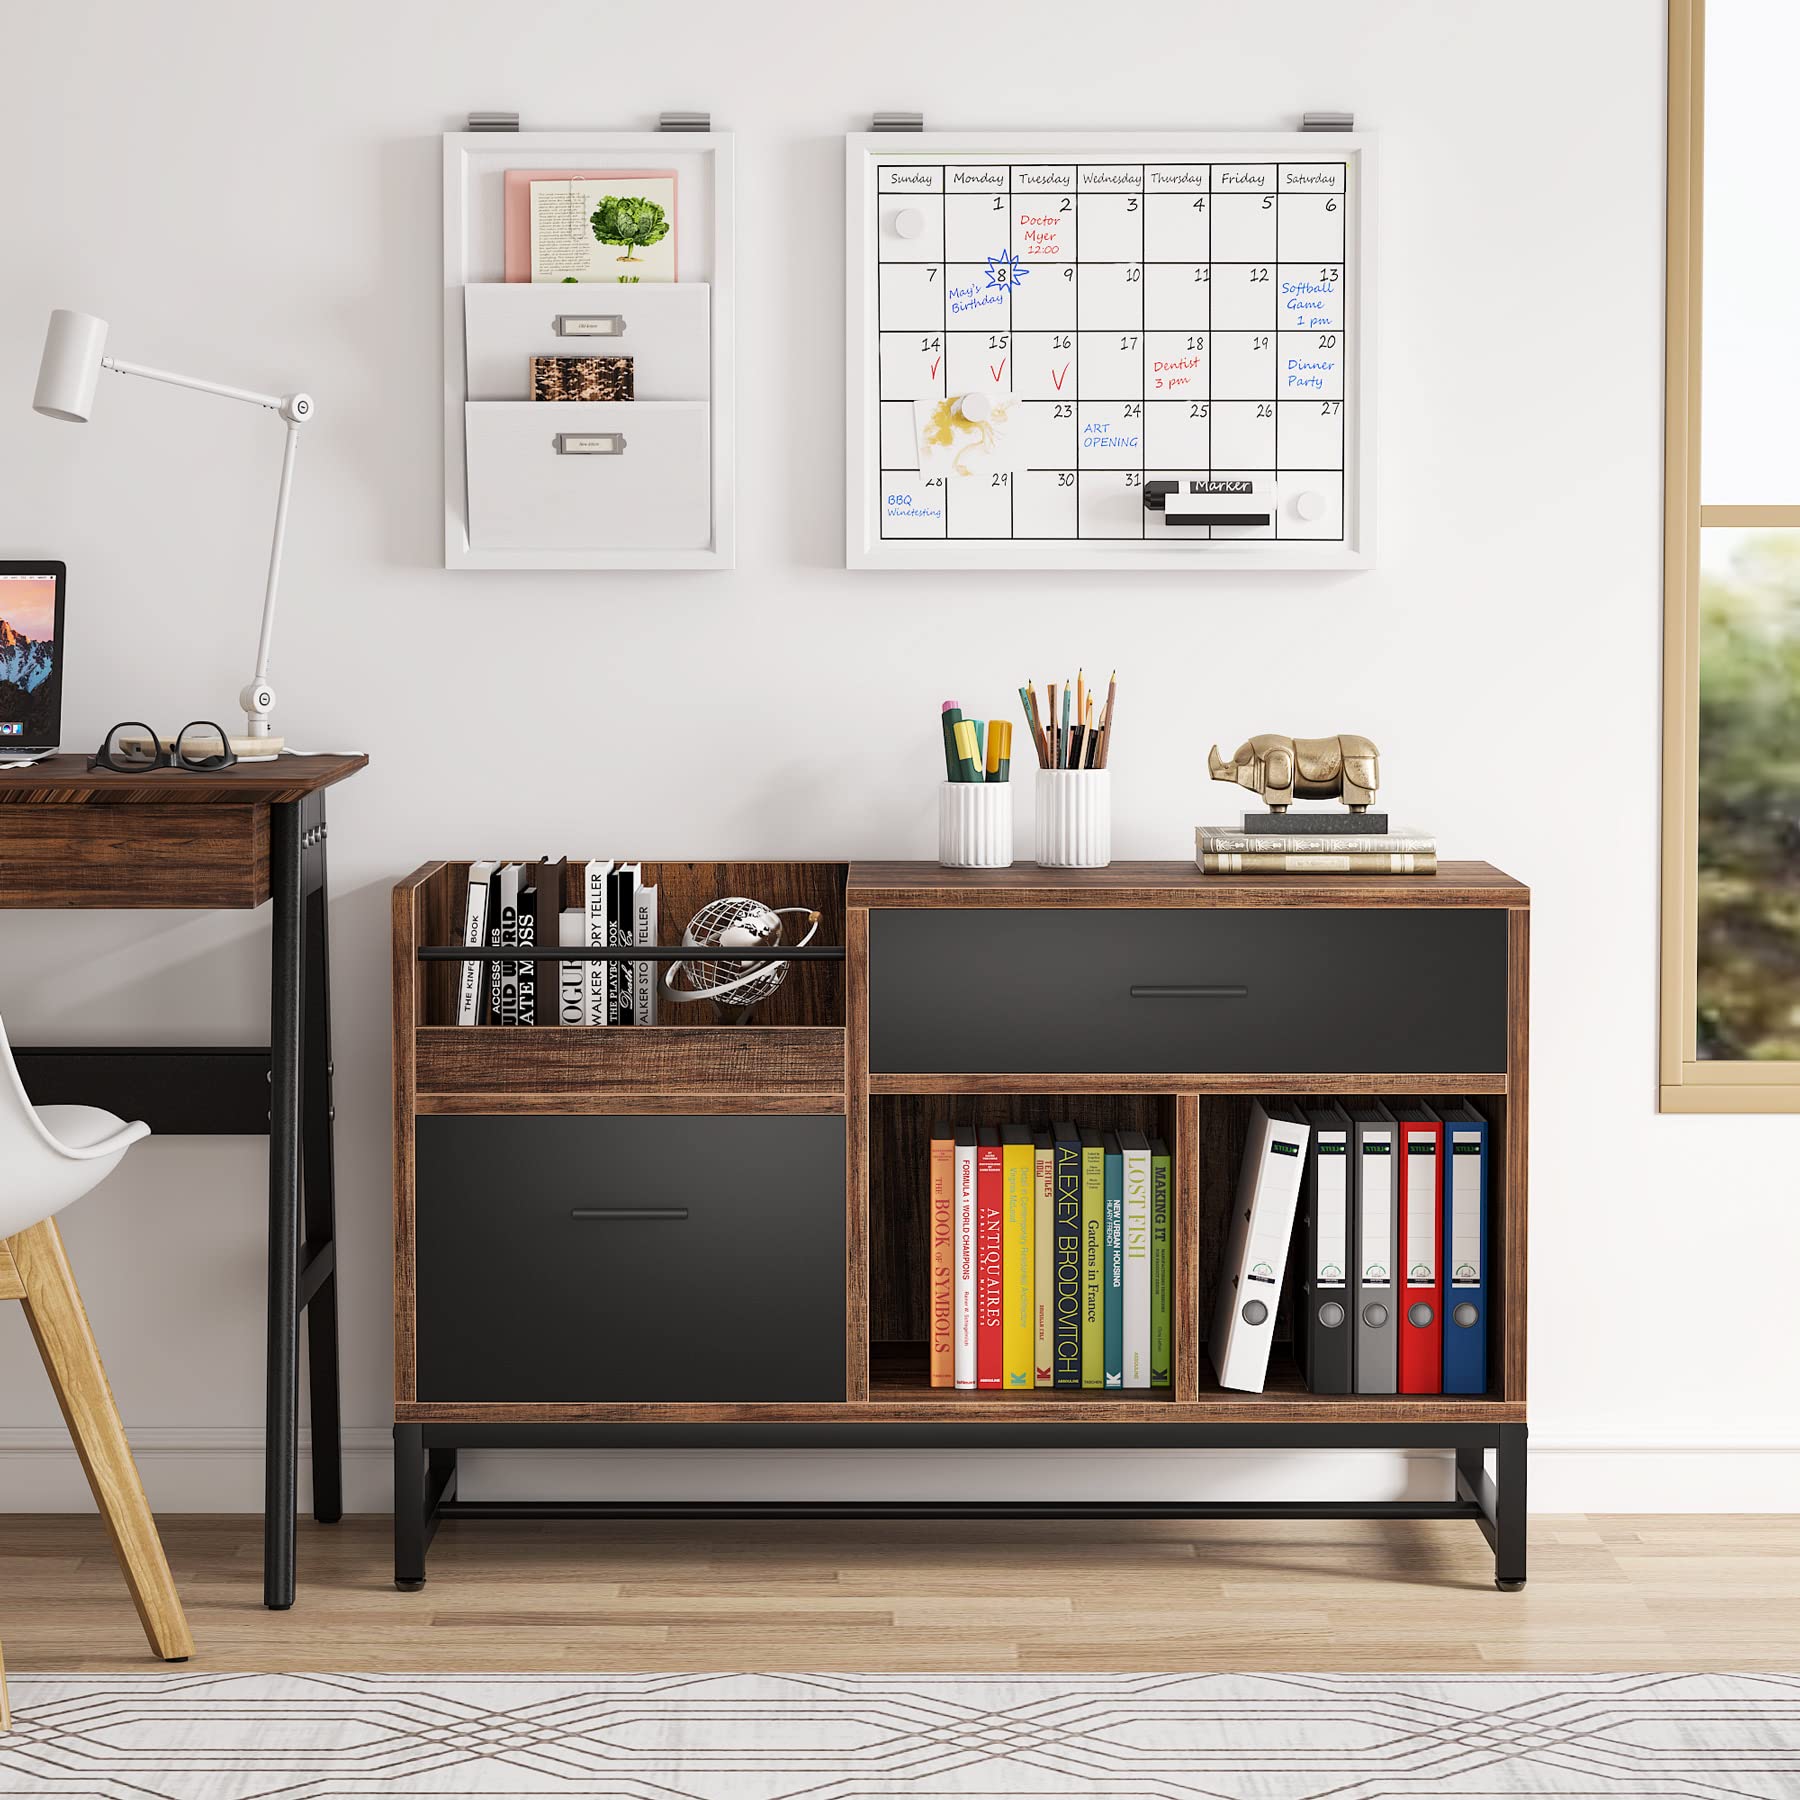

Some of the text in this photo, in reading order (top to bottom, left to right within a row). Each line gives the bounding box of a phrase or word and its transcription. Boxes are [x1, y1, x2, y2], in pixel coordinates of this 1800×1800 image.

[890, 173, 933, 187] Sunday
[953, 172, 1004, 186] Monday
[1019, 173, 1071, 186] Tuesday
[1083, 173, 1143, 187] Wednesday
[1151, 172, 1202, 186] Thursday
[1221, 173, 1265, 186] Friday
[1286, 173, 1336, 186] Saturday
[993, 197, 1004, 211] 1
[1059, 198, 1072, 213] 2
[1126, 198, 1138, 212] 3
[1193, 197, 1206, 212] 4
[1261, 196, 1275, 210] 5
[1325, 198, 1337, 212] 6
[1020, 214, 1061, 226] Doctor
[1024, 230, 1056, 244] Myer
[1027, 245, 1060, 255] 12:00
[926, 268, 937, 282] 7
[997, 268, 1006, 282] 8
[1063, 268, 1073, 282] 9
[1126, 268, 1140, 282] 10
[1194, 268, 1210, 282] 11
[1250, 268, 1269, 282] 12
[1319, 268, 1339, 282] 13
[949, 284, 981, 300] May's
[1281, 282, 1334, 296] Softball
[951, 294, 1003, 314] Birthday
[1286, 298, 1325, 310] Game
[1296, 315, 1333, 328] 1 pm
[921, 337, 941, 352] 14
[988, 335, 1010, 349] 15
[1052, 335, 1071, 349] 16
[1120, 337, 1138, 350] 17
[1186, 337, 1204, 350] 18
[1253, 337, 1269, 350] 19
[1318, 335, 1336, 349] 20
[1153, 356, 1200, 372] Dentist
[1287, 359, 1335, 371] Dinner
[1155, 377, 1191, 390] 3 pm
[1288, 375, 1323, 389] Party
[1053, 404, 1072, 419] 23
[1123, 404, 1141, 418] 24
[1189, 404, 1208, 418] 25
[1256, 404, 1273, 418] 26
[1321, 402, 1340, 416] 27
[1083, 423, 1110, 433] ART
[1083, 437, 1139, 448] OPENING
[991, 473, 1008, 488] 29
[1058, 473, 1075, 487] 30
[1125, 473, 1141, 487] 31
[1194, 480, 1251, 492] Marker
[887, 494, 913, 506] BBQ
[887, 508, 942, 518] Winetesting
[639, 906, 649, 944] TELLER
[502, 906, 517, 977] WRLD
[591, 874, 602, 1026] WALKER SORY TELLER
[464, 993, 473, 1012] THE
[470, 915, 479, 944] BOOK
[492, 928, 501, 1014] ACCESSIES
[610, 920, 618, 1022] THE PLAYBO BOOK
[562, 960, 584, 1026] OGUE
[618, 963, 634, 1010] Death
[519, 981, 534, 1026] ATE
[639, 988, 649, 1026] ALKER
[962, 1159, 970, 1197] FORMULA
[1044, 1160, 1053, 1198] TEXTILES
[1128, 1157, 1146, 1259] LOST FISH
[1155, 1166, 1166, 1242] MAKING IT
[962, 1204, 970, 1233] WORLD
[1113, 1199, 1121, 1288] NEW URBAN HOUSING
[962, 1233, 970, 1280] CHAMPIONS
[1057, 1147, 1079, 1374] ALEXEY BRODOVITCH
[935, 1177, 951, 1354] THE BOOK OF SYMBOLS
[986, 1208, 1000, 1327] ANTIQUAIRES
[1088, 1219, 1100, 1323] Gardens in France
